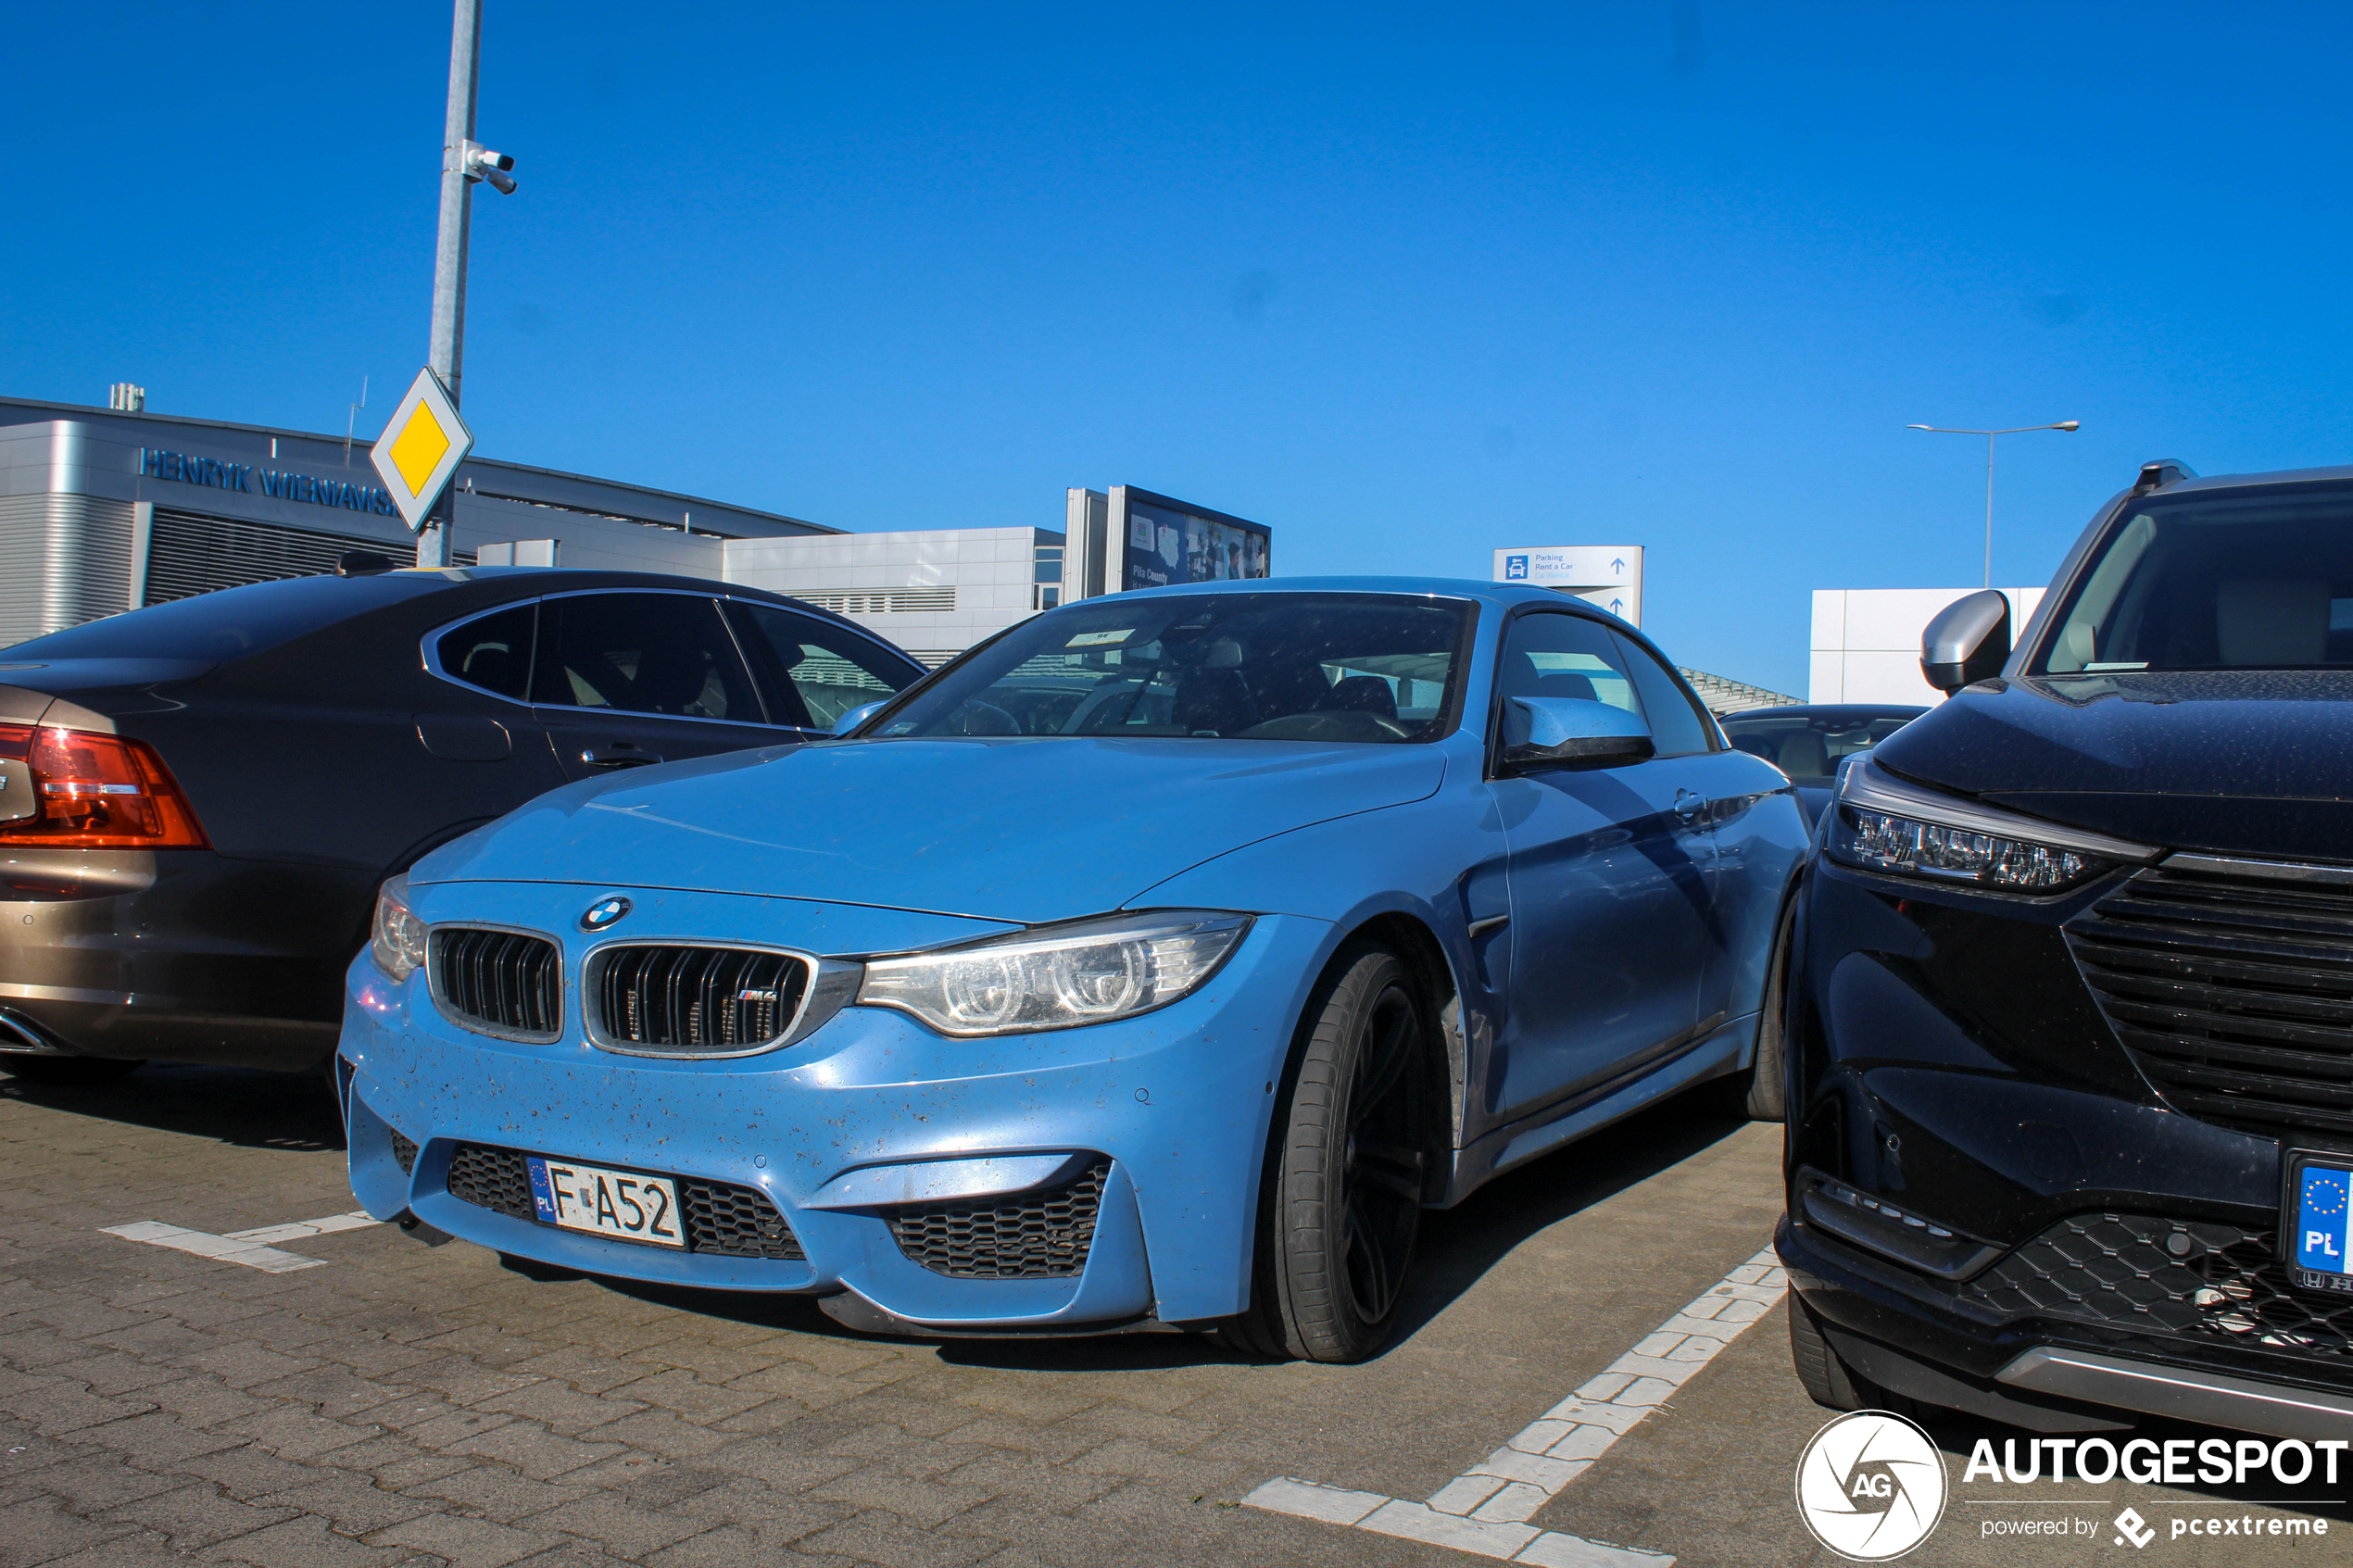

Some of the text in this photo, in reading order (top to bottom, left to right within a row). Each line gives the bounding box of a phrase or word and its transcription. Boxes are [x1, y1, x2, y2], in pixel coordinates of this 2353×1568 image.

[140, 447, 251, 493] HENRYK
[1535, 554, 1564, 562] Parking
[1147, 568, 1168, 585] County
[536, 1196, 554, 1212] PL
[550, 1167, 675, 1237] F A52
[2305, 1230, 2340, 1256] PL
